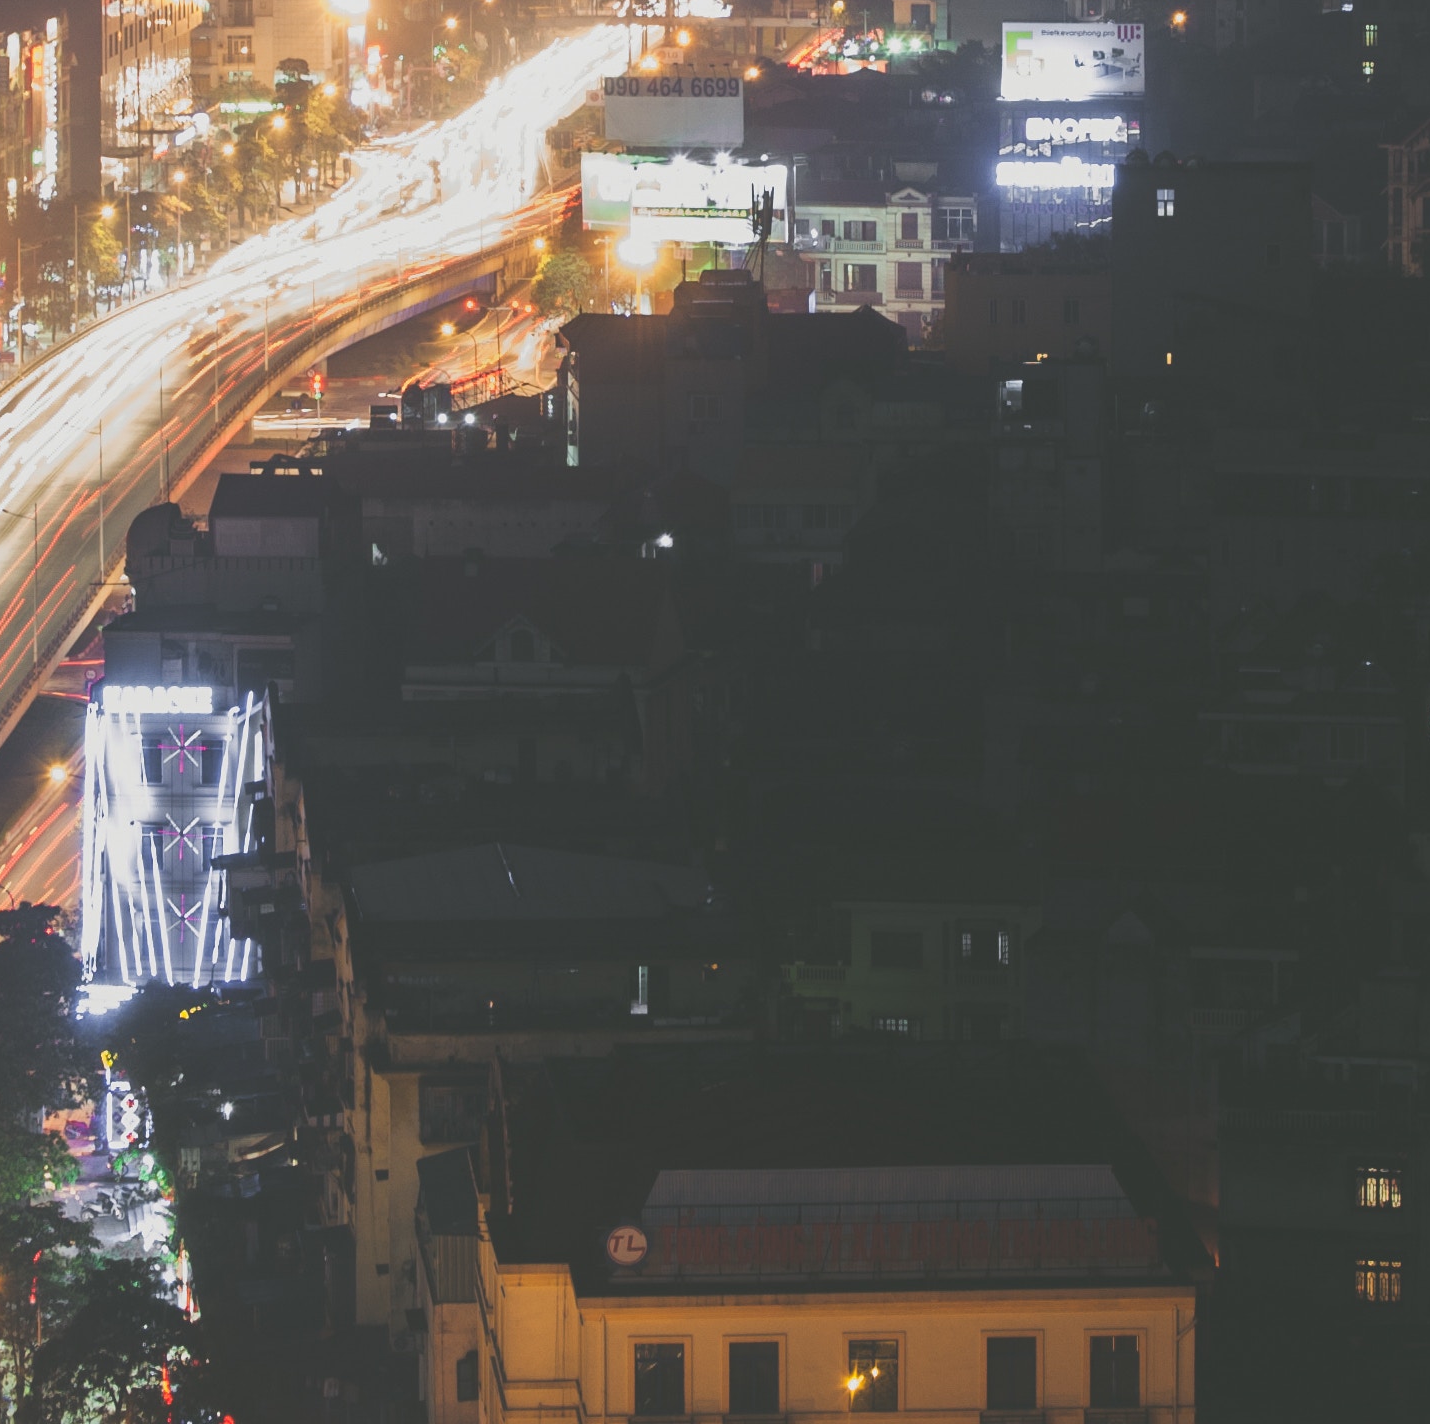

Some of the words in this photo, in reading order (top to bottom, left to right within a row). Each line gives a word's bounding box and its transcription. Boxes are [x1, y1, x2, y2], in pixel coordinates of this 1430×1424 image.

[604, 77, 640, 97] 090
[647, 77, 683, 97] 464
[690, 77, 739, 97] 6699
[736, 1216, 803, 1264] CÔNG
[811, 1221, 844, 1264] TY
